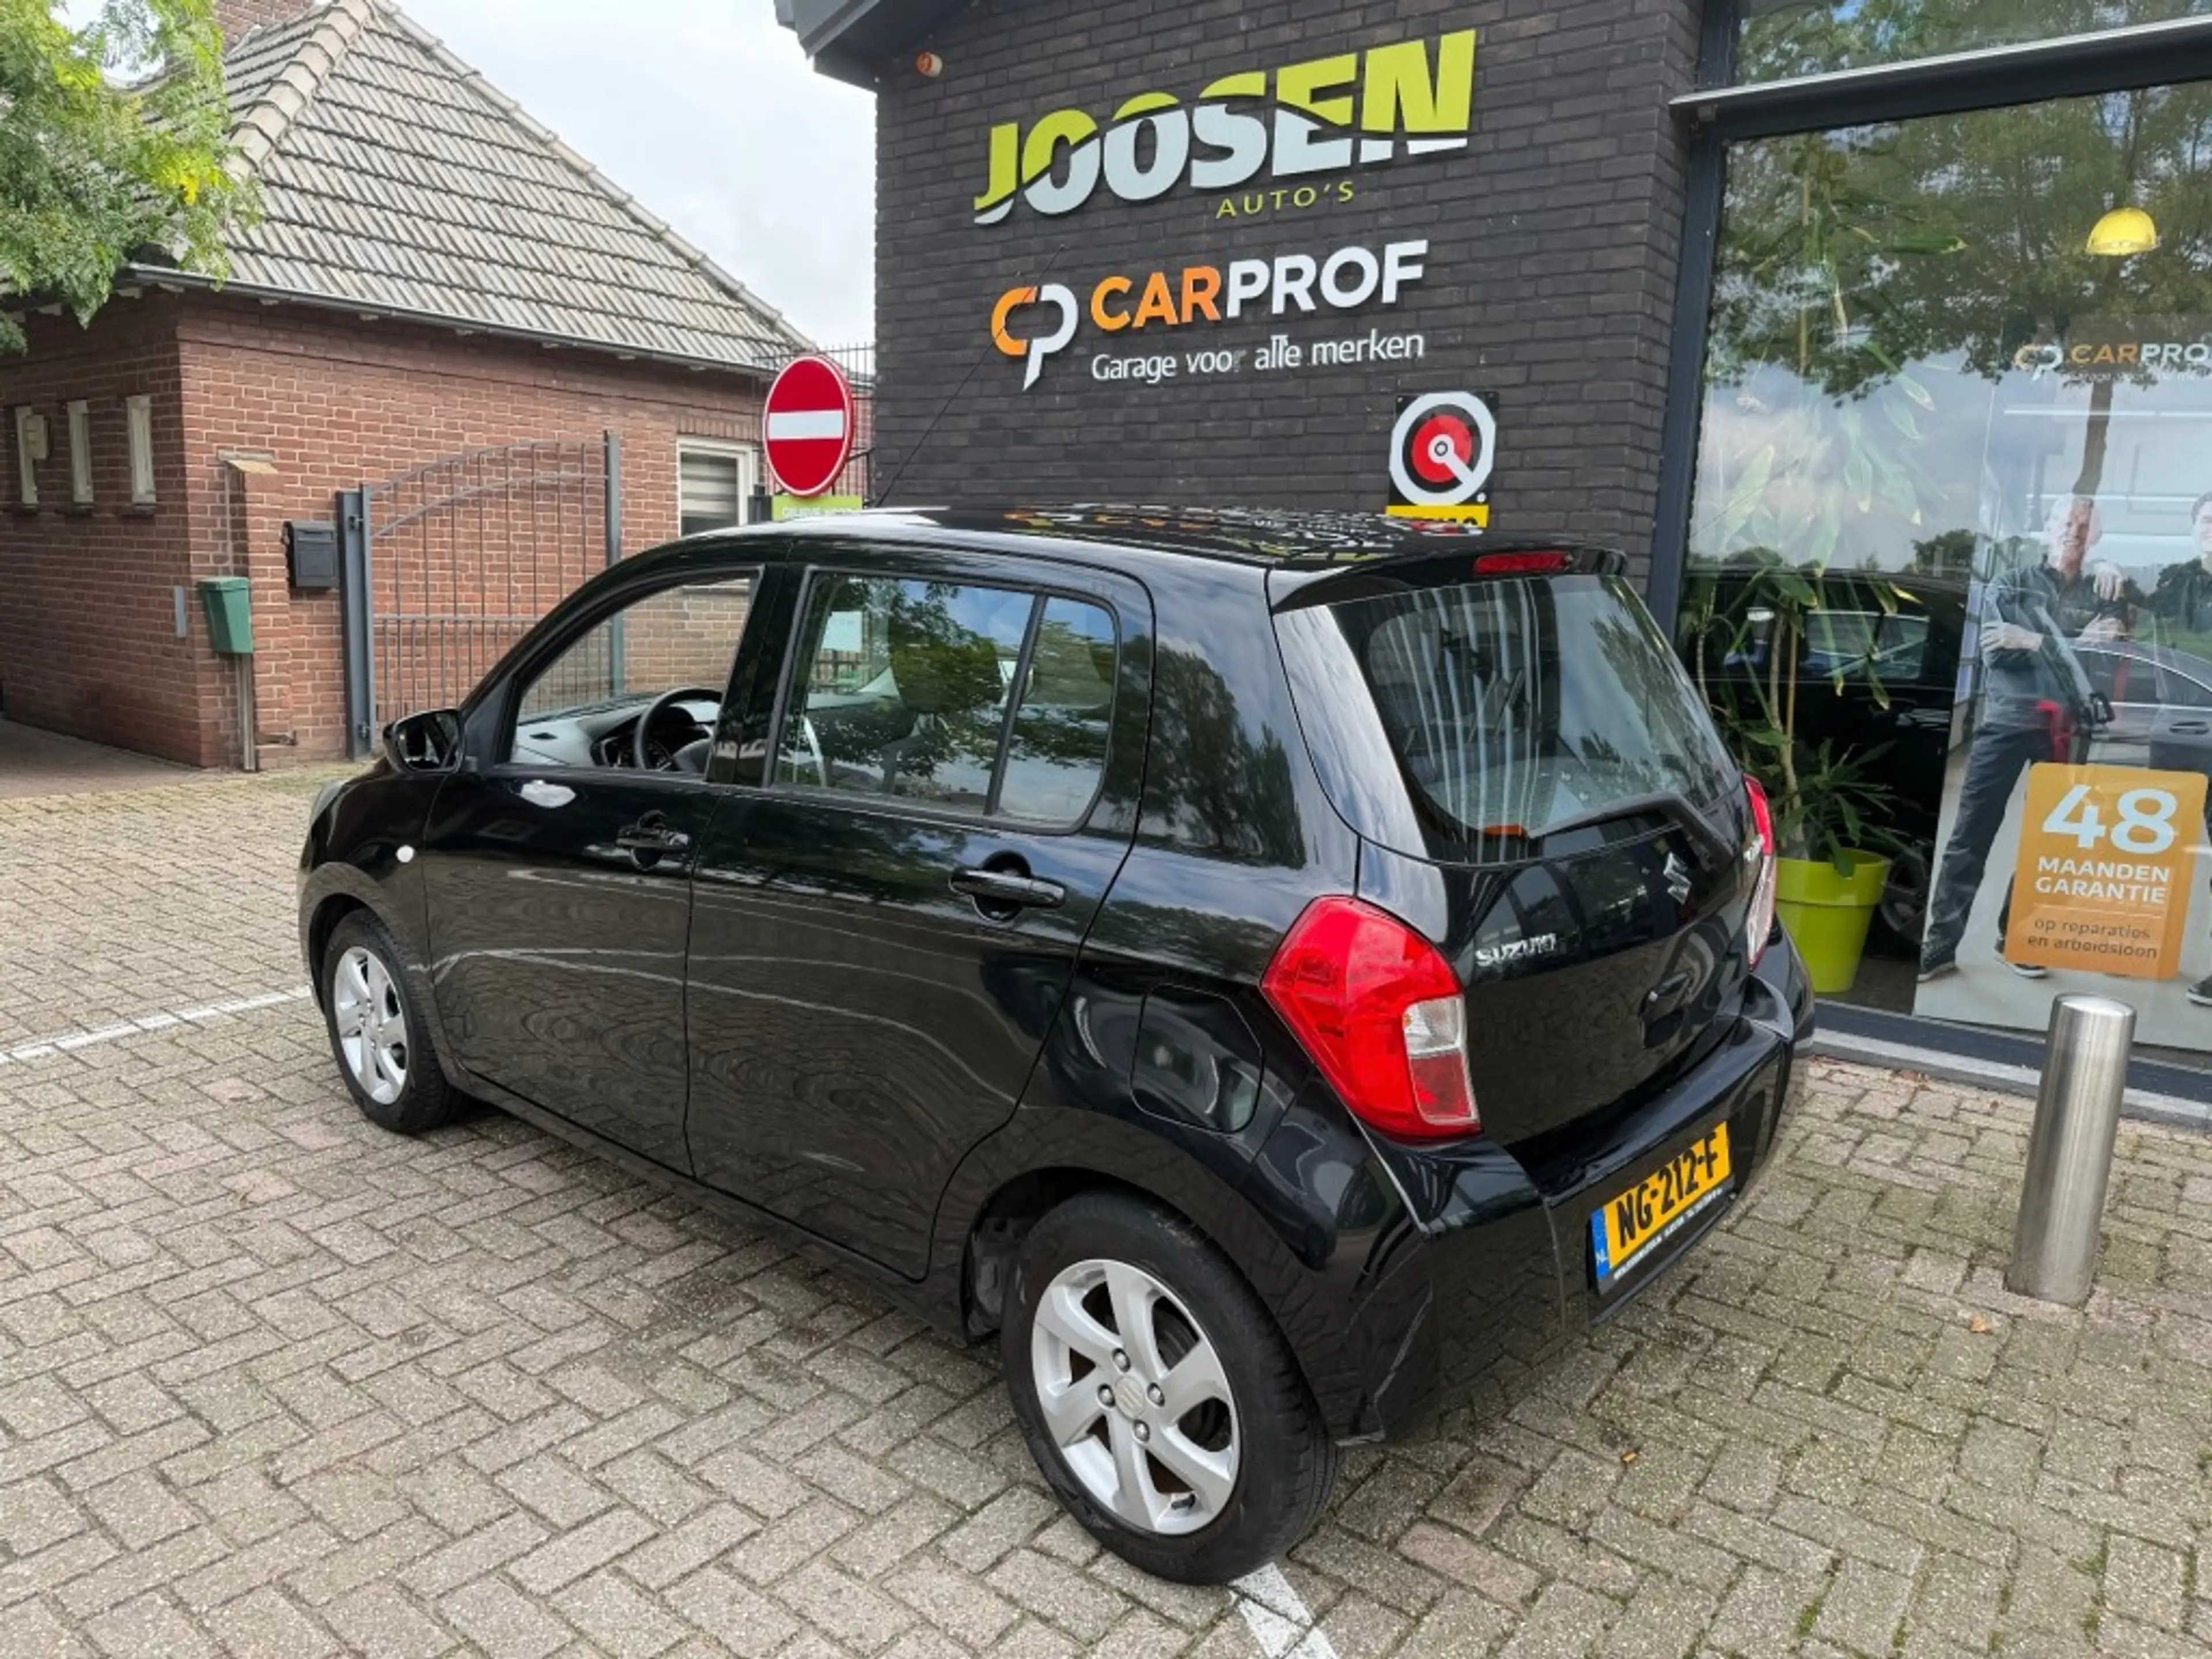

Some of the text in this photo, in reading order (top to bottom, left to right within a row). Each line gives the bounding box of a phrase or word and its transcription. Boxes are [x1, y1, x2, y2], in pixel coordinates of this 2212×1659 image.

[974, 29, 1476, 225] JOOSEN
[1215, 181, 1355, 219] AUTO'S
[1090, 240, 1428, 331] CARPROF
[1092, 328, 1425, 384] Garage voor alle merken
[2041, 783, 2179, 854] 48
[2034, 876, 2167, 904] GARANTIE
[2037, 855, 2171, 883] MAANDEN
[2027, 937, 2048, 947] en
[2033, 918, 2150, 940] op reparaties
[1616, 1131, 1718, 1248] NG-212-F
